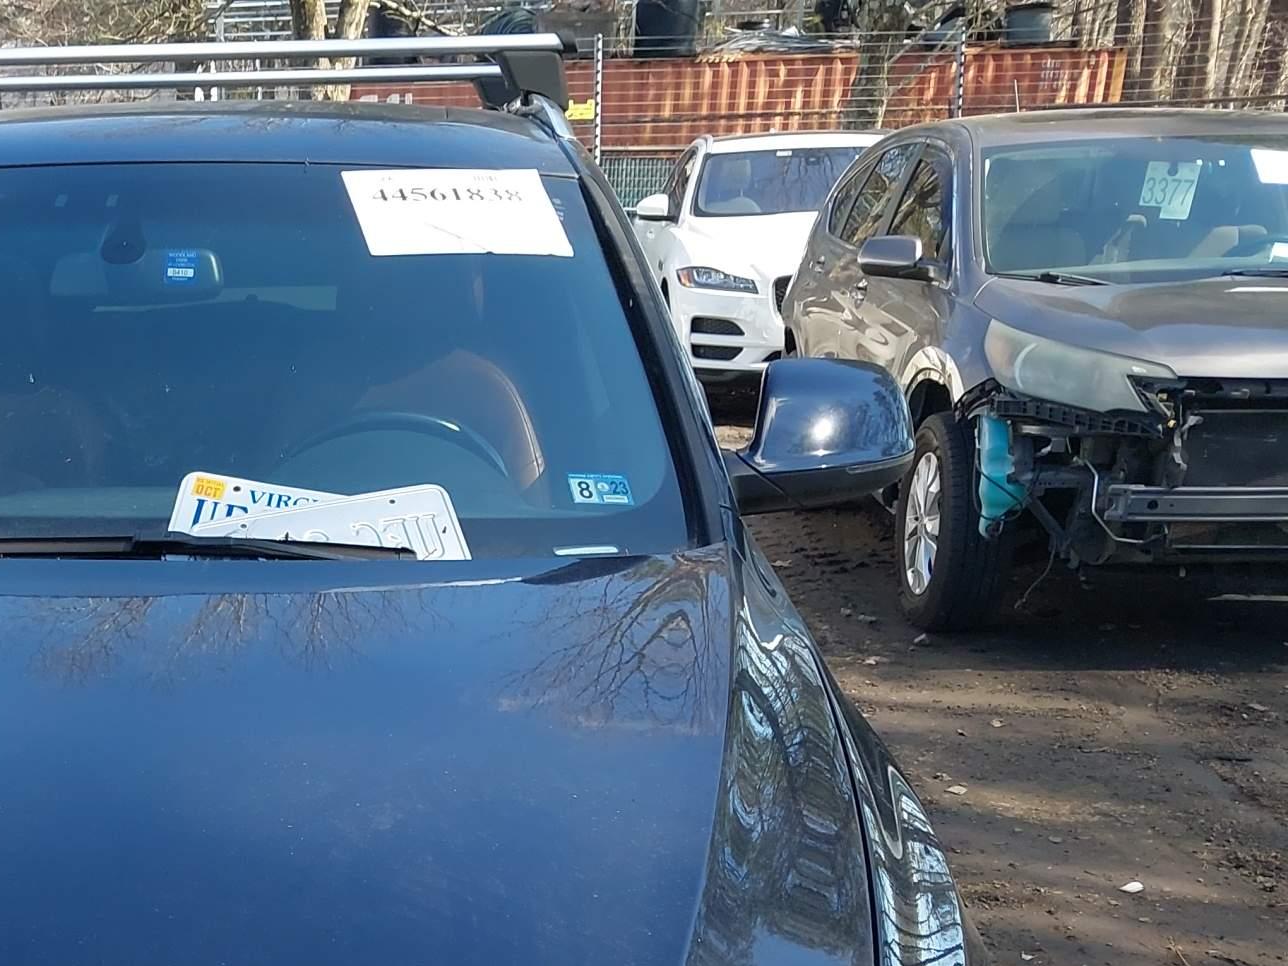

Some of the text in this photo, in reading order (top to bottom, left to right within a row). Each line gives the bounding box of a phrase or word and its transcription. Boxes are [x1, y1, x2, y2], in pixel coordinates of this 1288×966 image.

[372, 187, 523, 202] 44561838
[1142, 177, 1195, 206] 3377
[196, 484, 221, 498] OCT
[577, 481, 629, 499] 8 23
